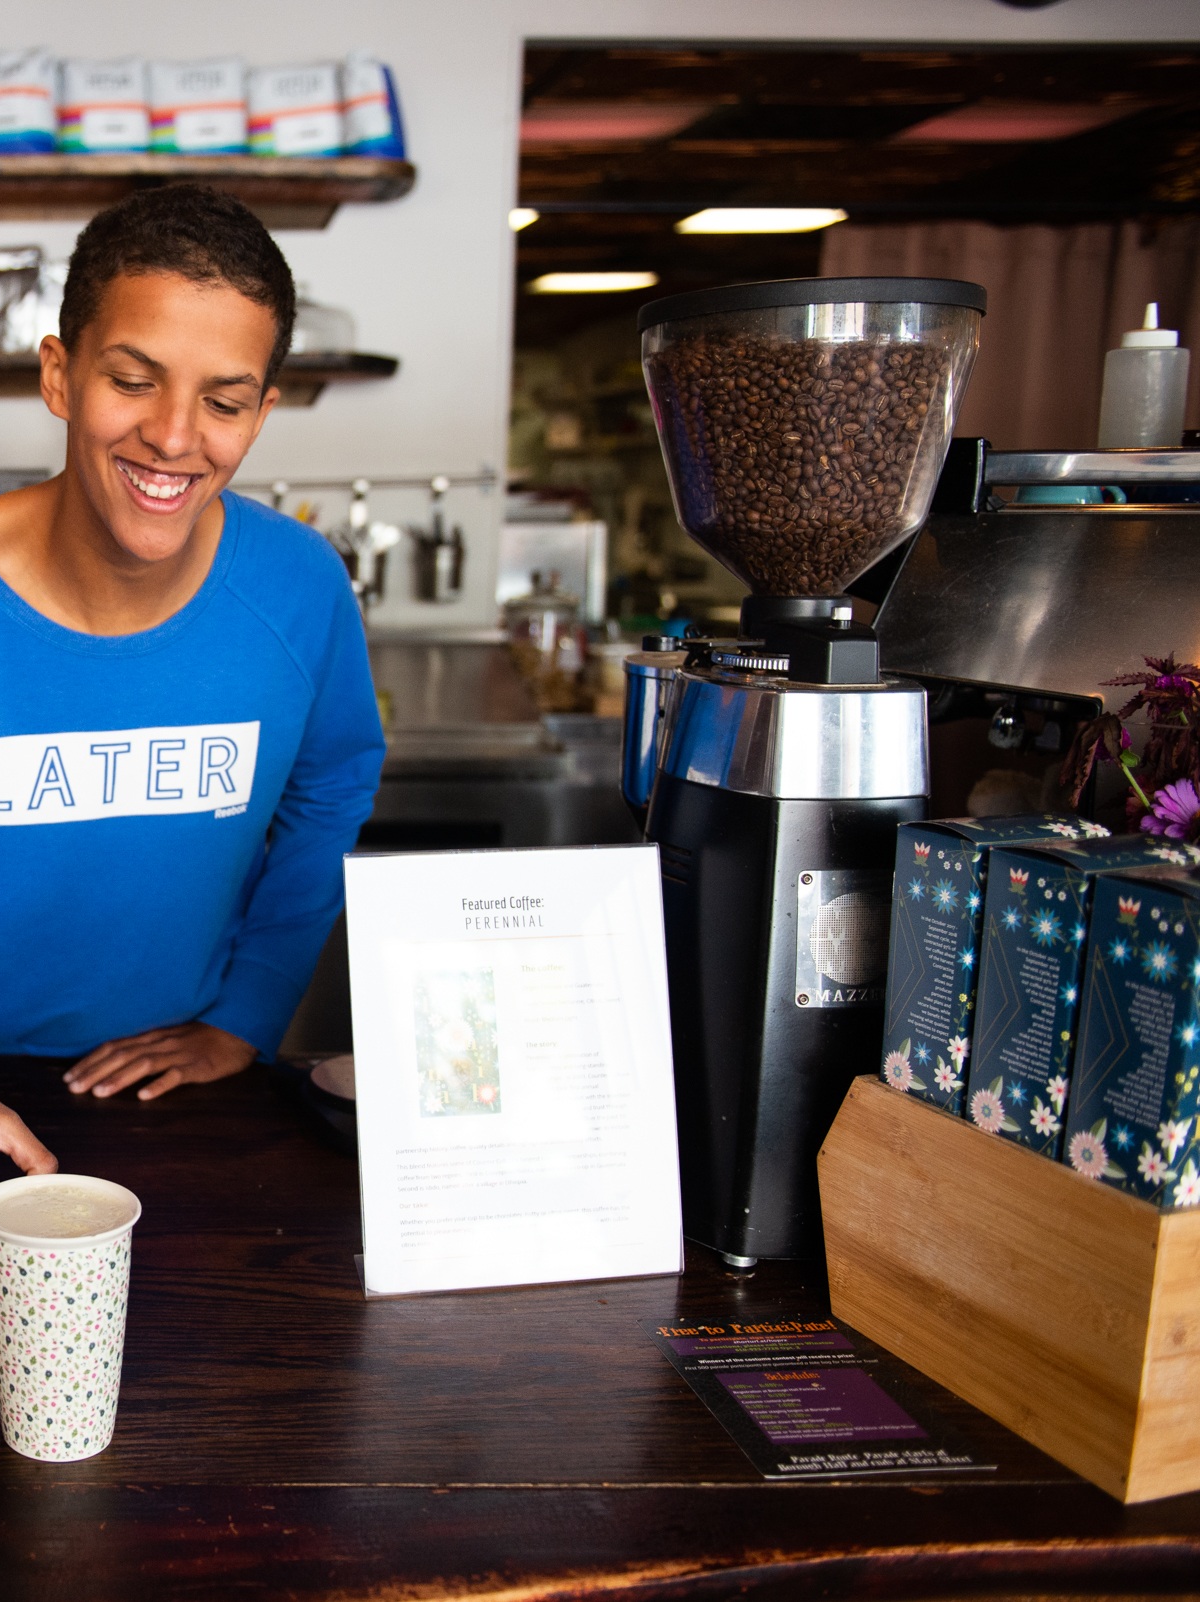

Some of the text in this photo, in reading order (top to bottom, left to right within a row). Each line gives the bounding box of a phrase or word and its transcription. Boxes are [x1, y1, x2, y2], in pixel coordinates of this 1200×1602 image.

[462, 896, 544, 910] Featured Coffee:
[465, 915, 544, 930] PERENNIAL
[928, 925, 948, 934] September
[924, 939, 943, 948] contracted
[933, 963, 954, 974] Contracting
[935, 986, 952, 994] producer
[931, 992, 946, 1000] partners
[910, 1011, 924, 1022] knowing
[658, 1326, 699, 1337] Free
[704, 1325, 725, 1336] to
